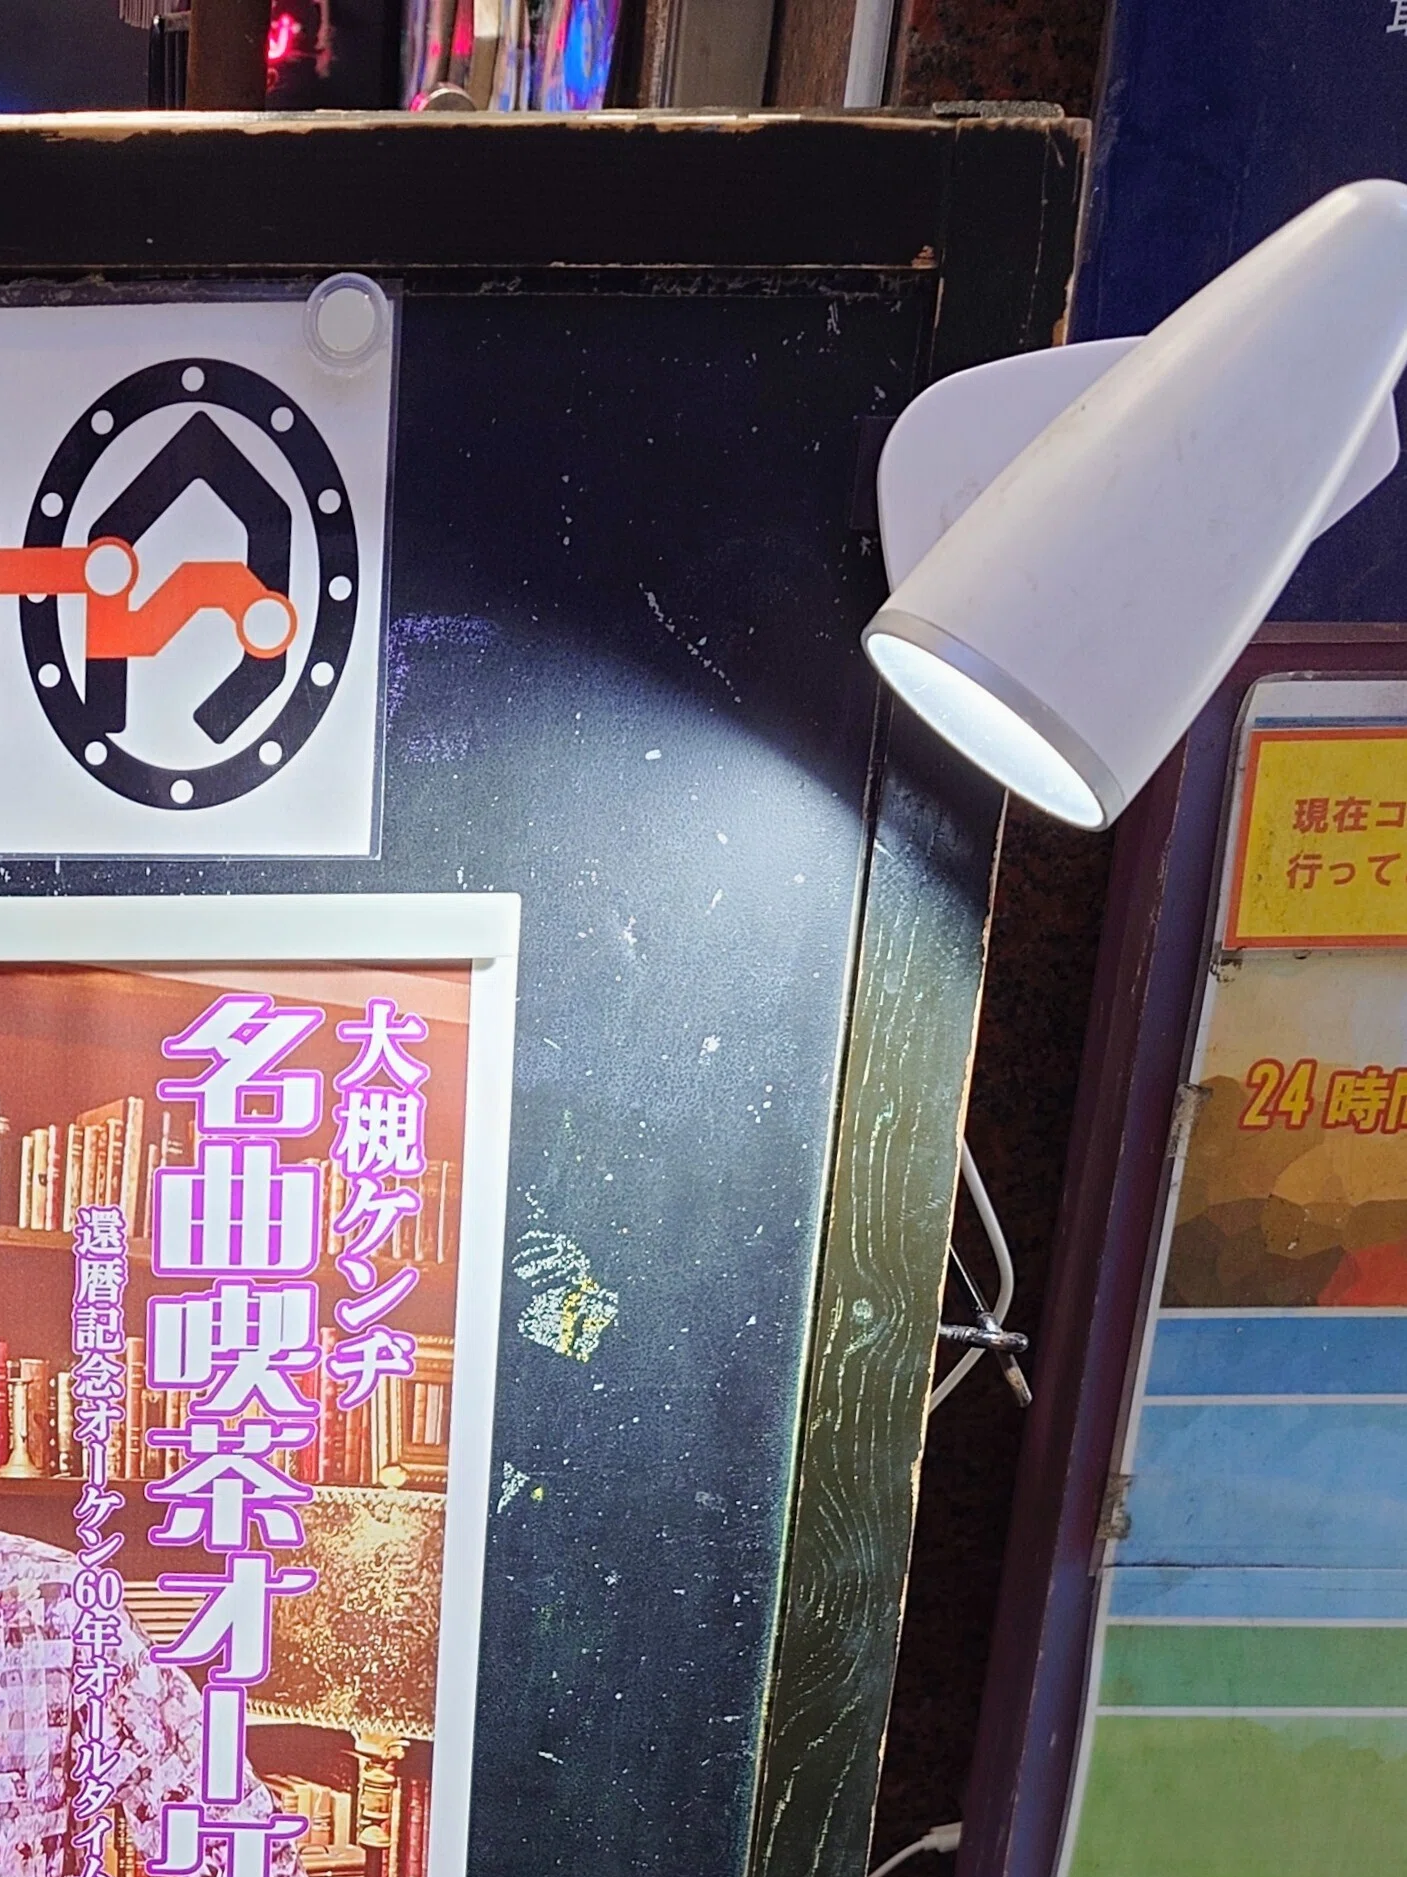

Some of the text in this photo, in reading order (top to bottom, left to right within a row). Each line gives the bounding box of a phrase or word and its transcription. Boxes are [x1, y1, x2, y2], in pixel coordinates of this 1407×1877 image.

[1286, 853, 1407, 890] 行って
[327, 997, 428, 1412] 大槻ケンヂ
